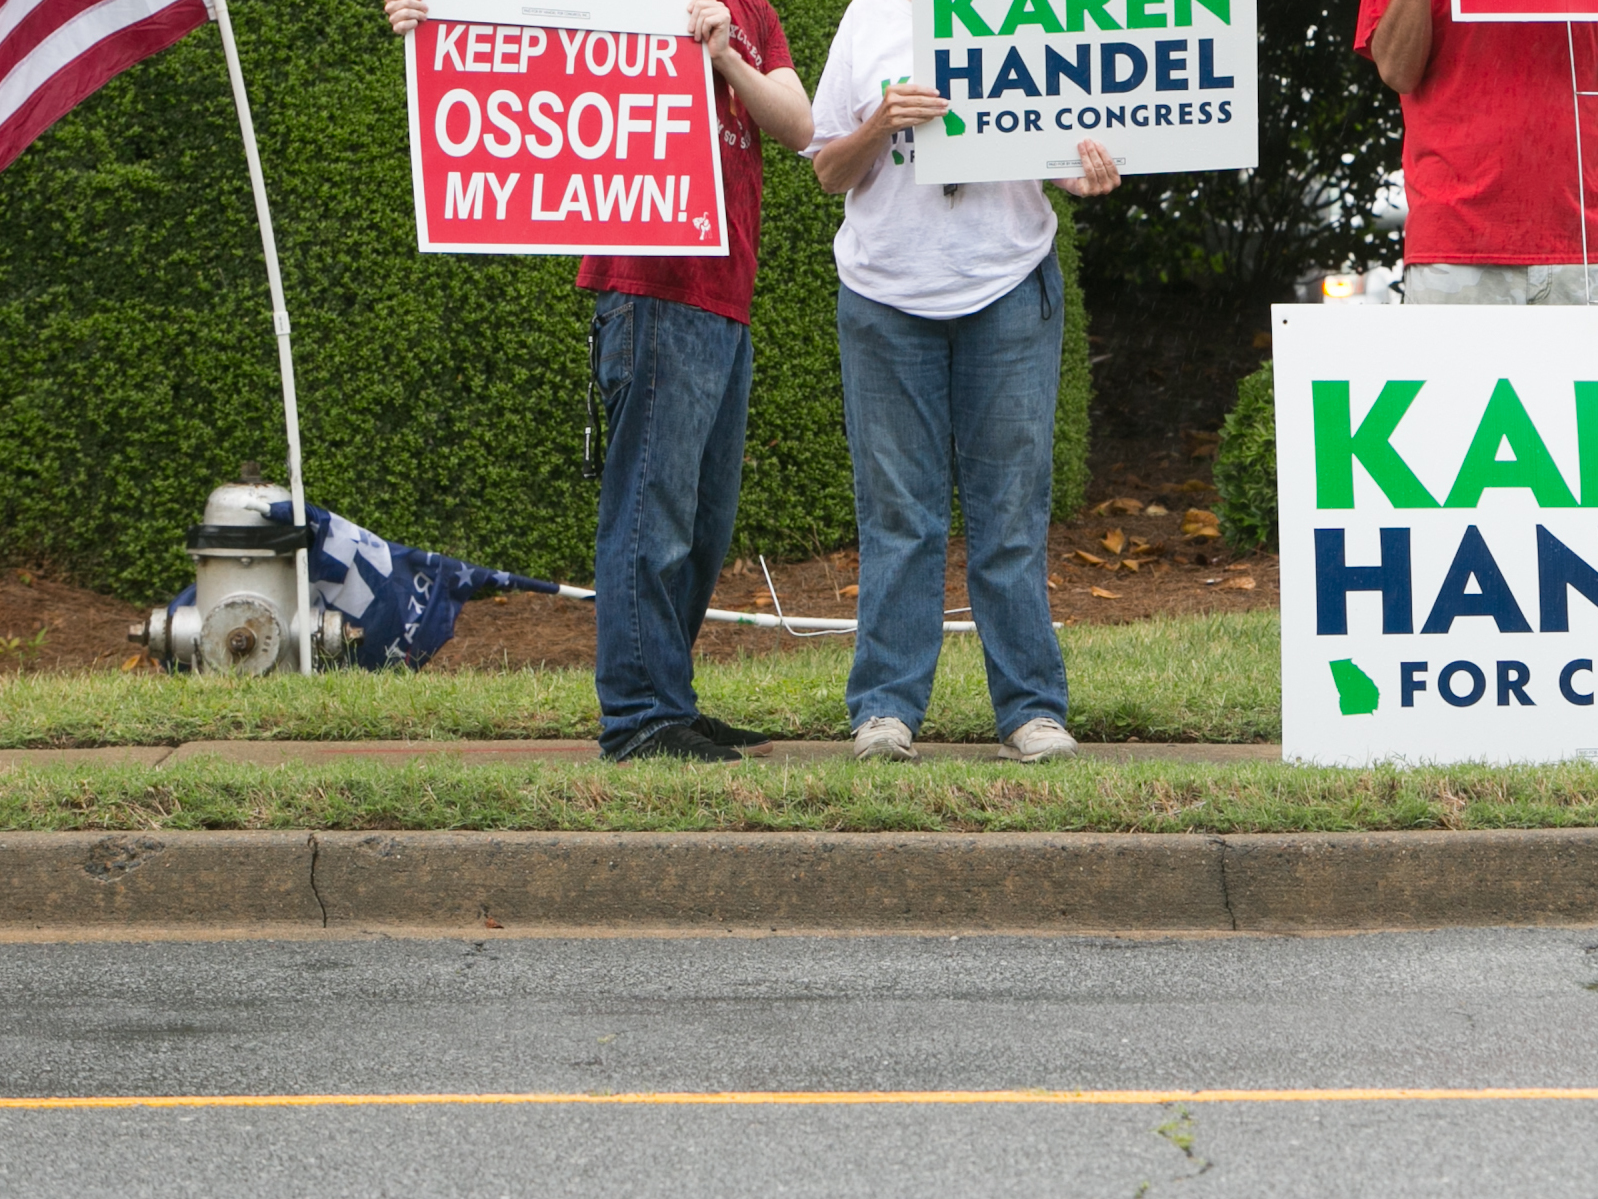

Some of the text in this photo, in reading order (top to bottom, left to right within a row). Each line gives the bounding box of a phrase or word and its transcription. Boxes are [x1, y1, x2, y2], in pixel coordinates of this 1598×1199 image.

[434, 25, 678, 77] KEEP YOUR
[934, 38, 1235, 100] HANDEL
[435, 88, 693, 160] OSSOFF
[976, 101, 1232, 134] FOR CONGRESS
[444, 171, 691, 222] MY LAWN!
[1400, 659, 1537, 708] FOR
